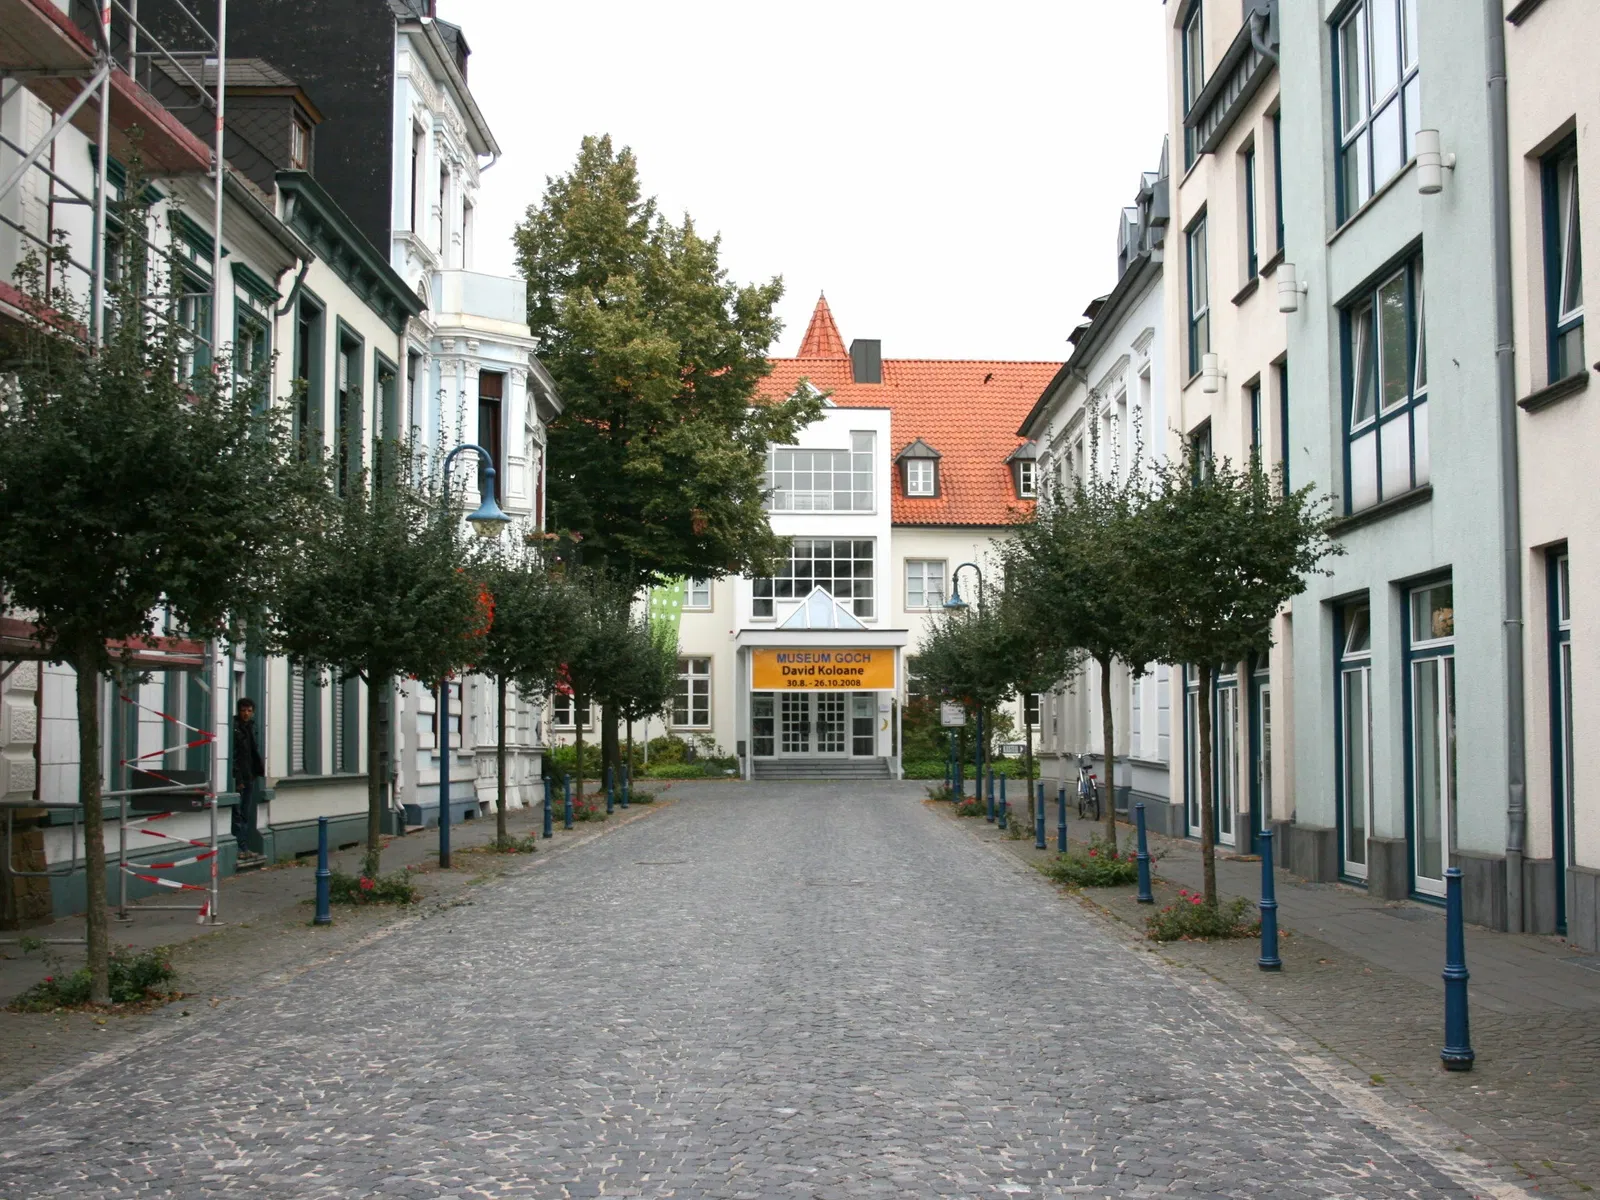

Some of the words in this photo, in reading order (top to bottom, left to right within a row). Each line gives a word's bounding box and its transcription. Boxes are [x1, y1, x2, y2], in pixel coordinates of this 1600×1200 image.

[777, 653, 831, 663] MUSEUM
[835, 653, 871, 663] GOCH
[782, 665, 815, 675] David
[818, 666, 864, 675] Koloane
[787, 679, 807, 687] 30.8.
[814, 679, 861, 687] 26.10.2008
